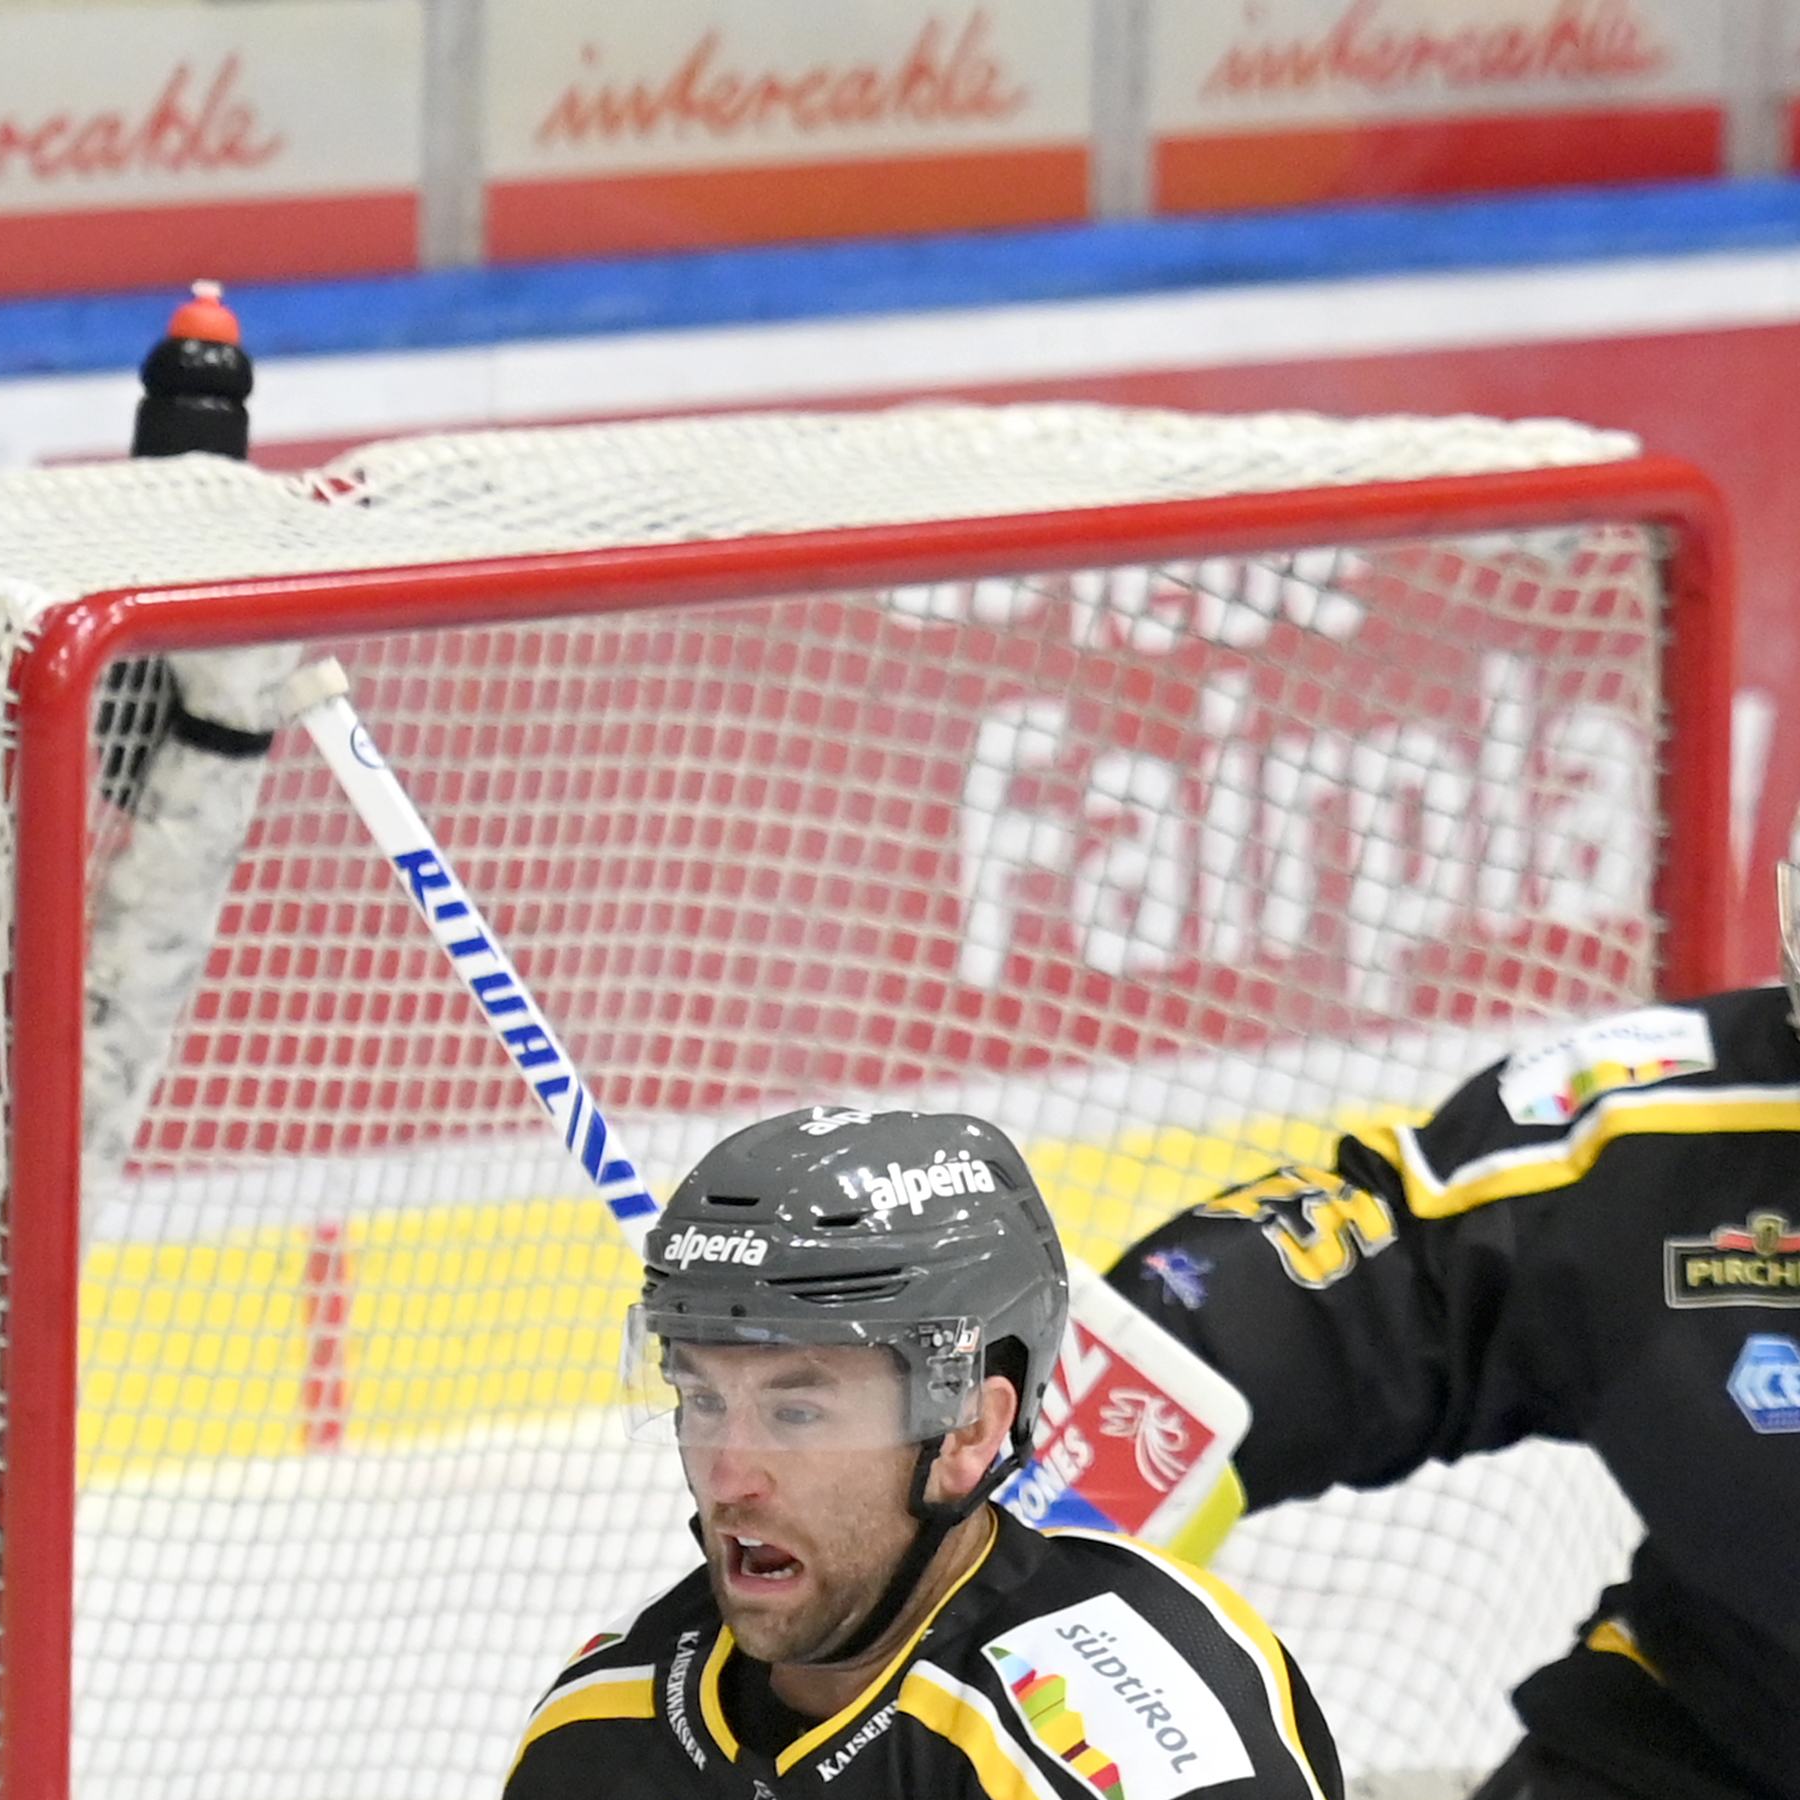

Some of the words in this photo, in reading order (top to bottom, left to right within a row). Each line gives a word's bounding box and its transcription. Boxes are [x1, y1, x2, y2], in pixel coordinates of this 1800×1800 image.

[537, 6, 1031, 148] intercable
[958, 648, 1775, 1012] Fairpla
[663, 1225, 769, 1271] alperia
